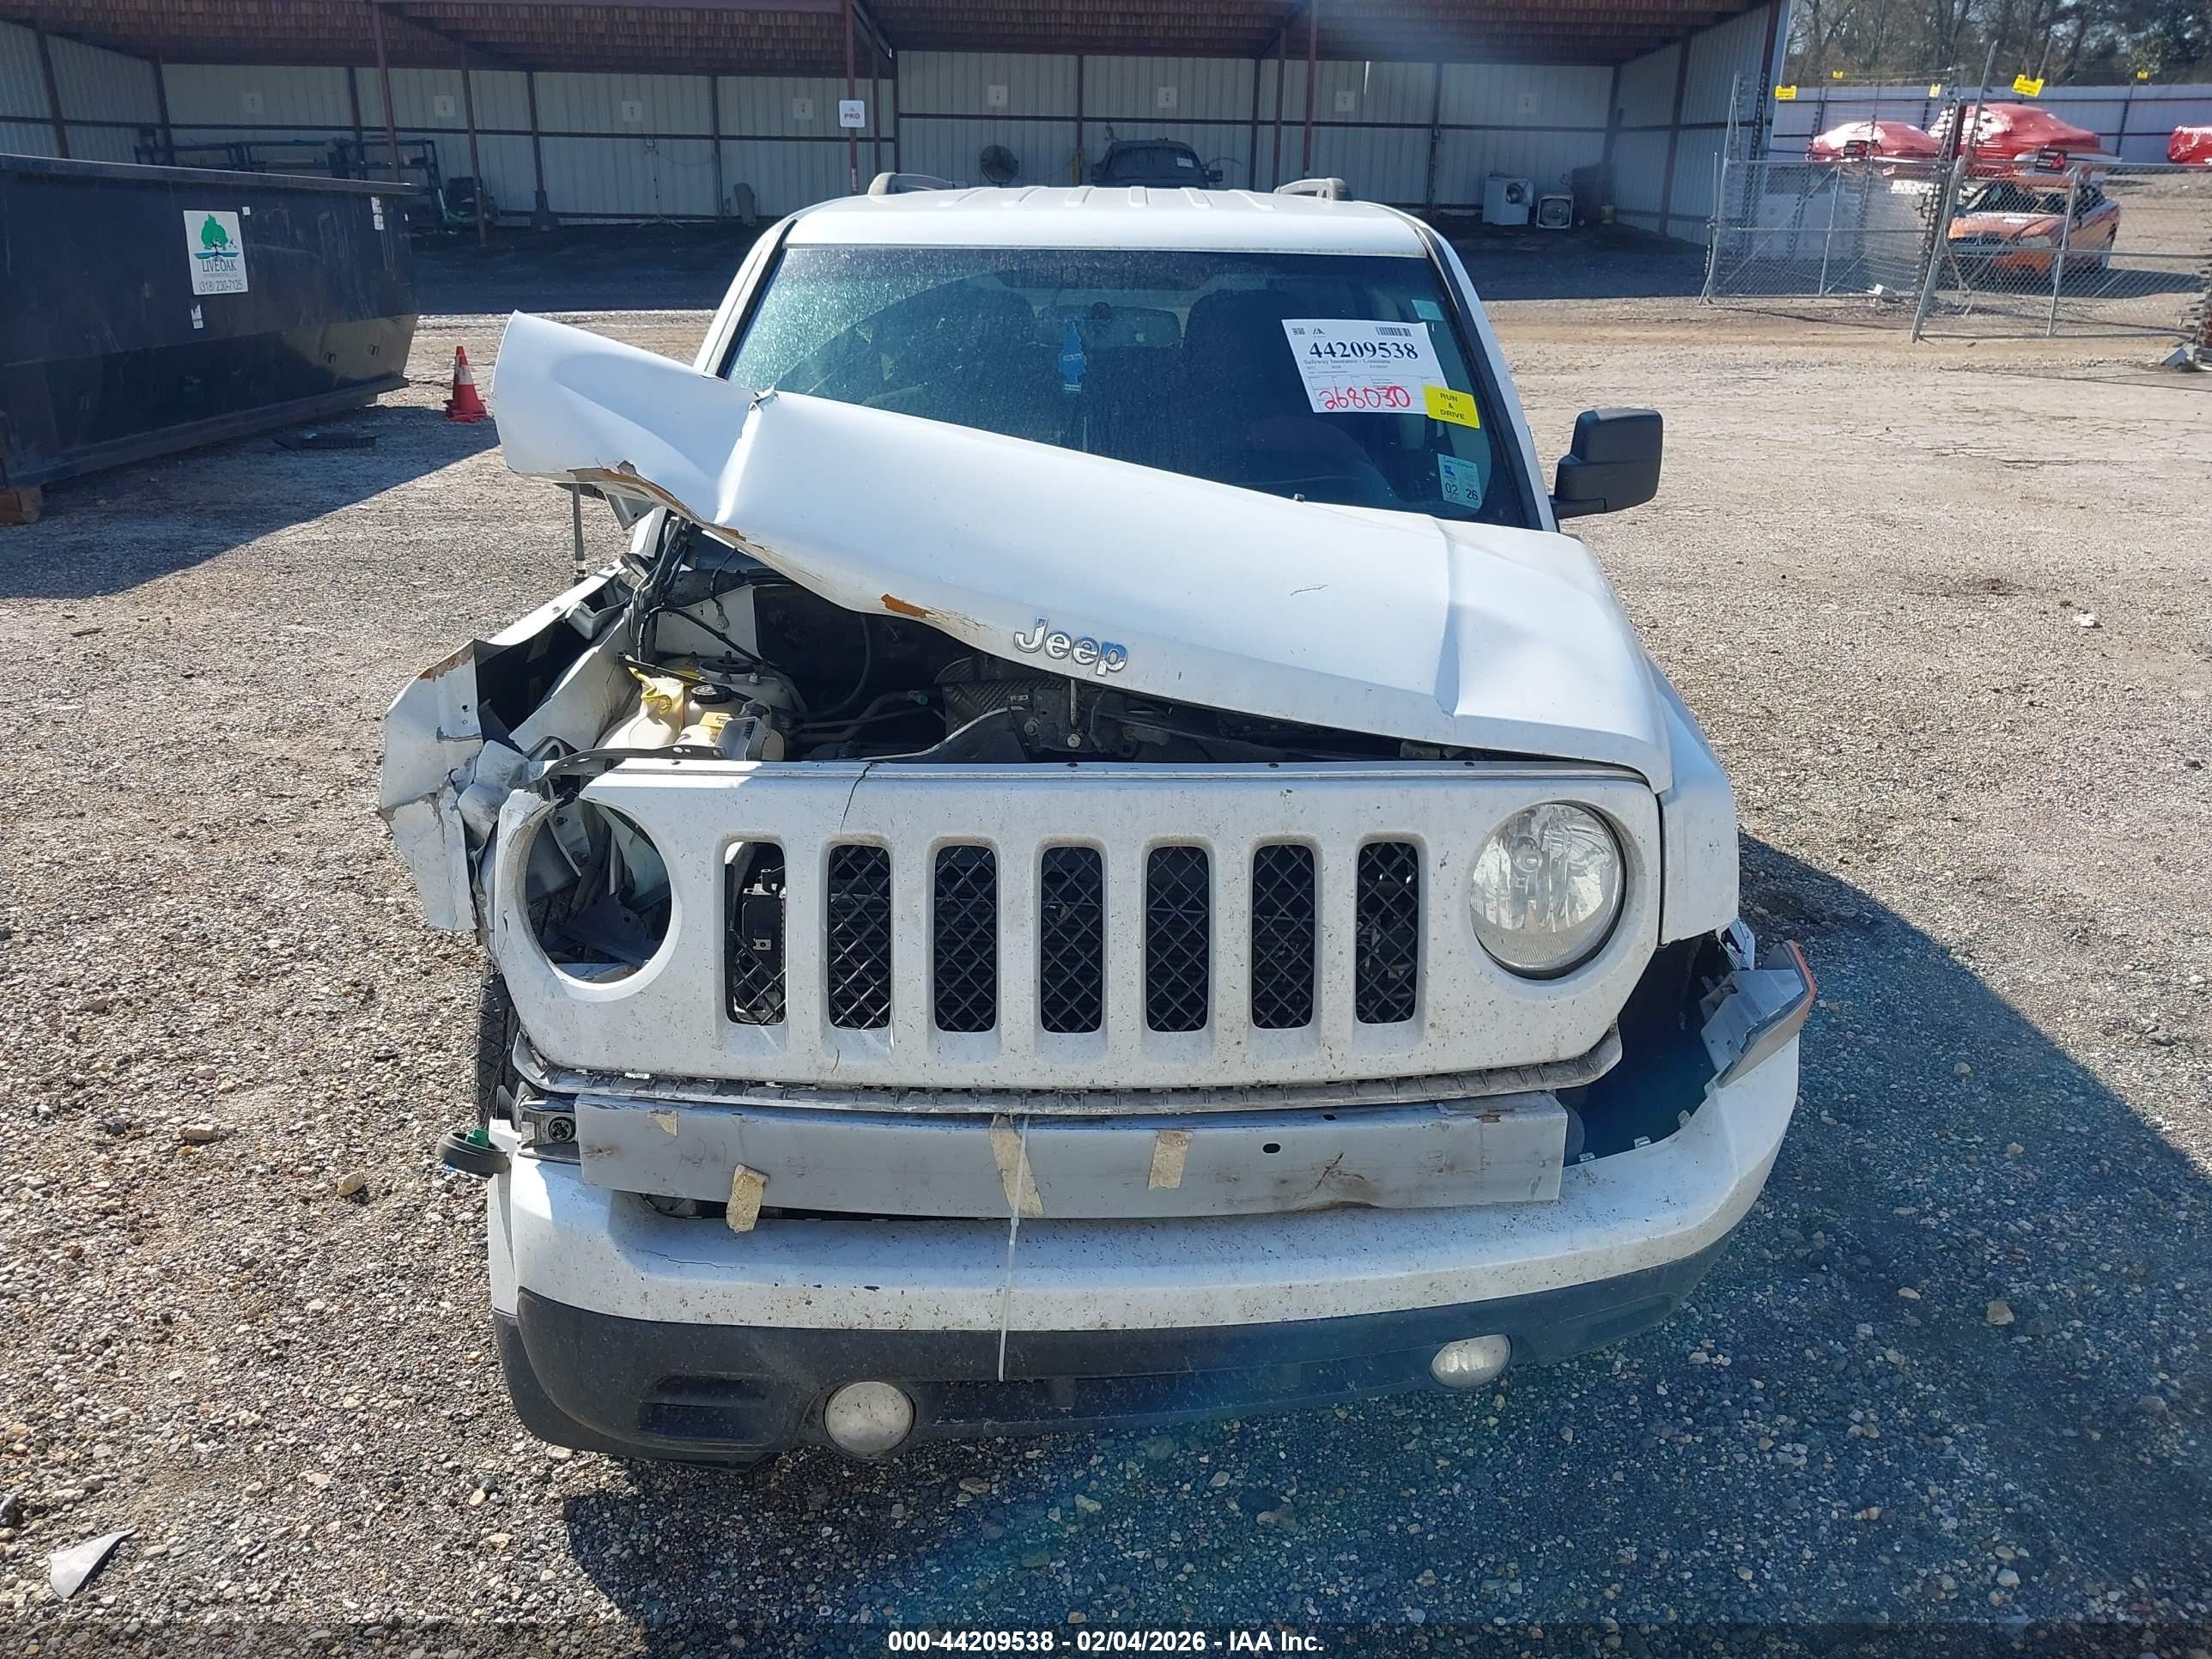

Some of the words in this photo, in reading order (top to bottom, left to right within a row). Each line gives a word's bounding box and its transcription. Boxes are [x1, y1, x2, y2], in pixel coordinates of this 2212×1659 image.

[1310, 342, 1419, 359] 44209538
[1440, 392, 1458, 402] RUN
[1440, 409, 1466, 420] DRIVE
[1445, 483, 1459, 495] 02
[1465, 489, 1479, 501] 26
[1013, 617, 1127, 677] Jeep
